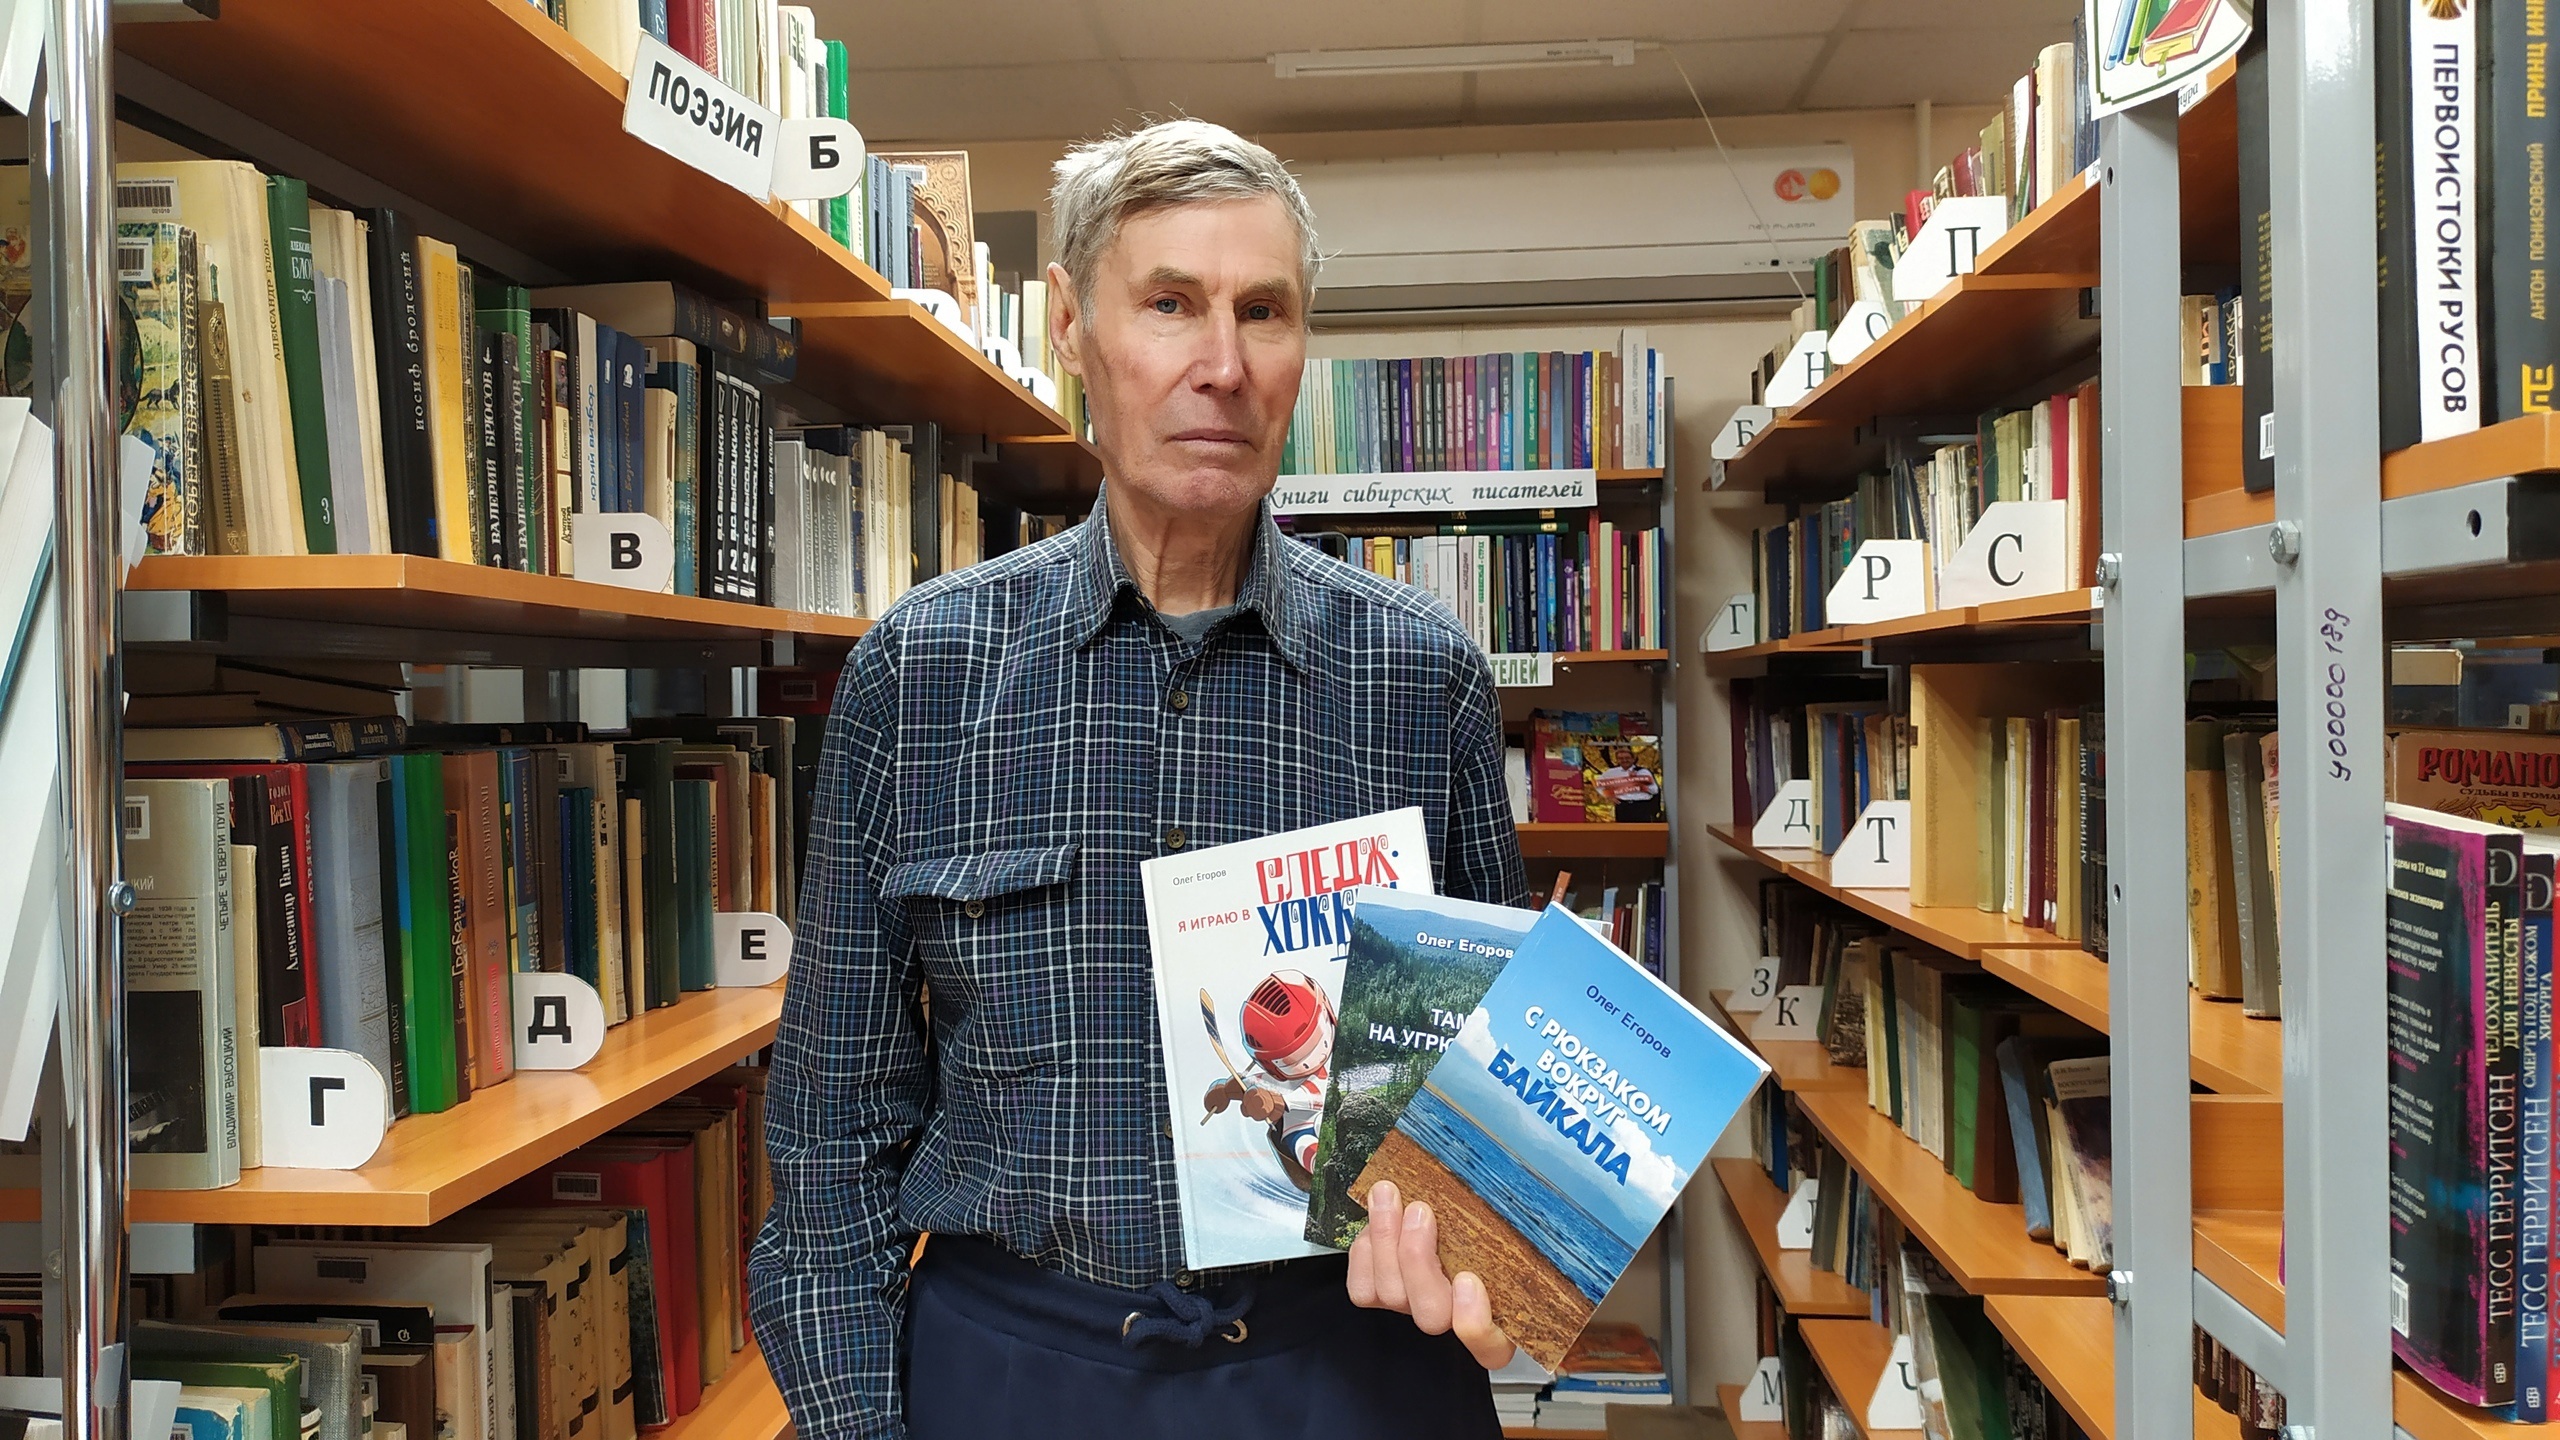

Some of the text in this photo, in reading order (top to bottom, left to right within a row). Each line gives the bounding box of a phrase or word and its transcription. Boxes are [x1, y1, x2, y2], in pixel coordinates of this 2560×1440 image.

[649, 60, 763, 158] ПОЭЗИЯ
[809, 134, 840, 170] Б
[2526, 42, 2546, 320] АНТОН ПОНИЗОВСКИЙ ПРИНЦ
[1944, 226, 1981, 278] П
[2432, 43, 2467, 413] ПЕРВОИСТОКИ РУСОВ
[184, 273, 197, 351] СТИХИ
[262, 238, 281, 362] АЛЕКСАНДР БЛОК
[400, 251, 425, 432] иосиф бродский
[521, 313, 532, 356] БУНИН
[604, 359, 611, 384] 1
[622, 363, 634, 389] 2
[1803, 350, 1828, 390] Н
[483, 370, 500, 546] ВАЛЕРИЙ БРЮСОВ
[586, 383, 597, 502] юрий визбор
[1734, 419, 1755, 448] Б
[511, 379, 528, 551] ВАЛЕРИЙ БРЮСОВ
[716, 414, 725, 571] 1 ВЫСОЦКИЙ
[751, 427, 760, 522] ВЫСОЦКИЙ
[321, 497, 331, 526] 3
[729, 417, 738, 571] 2 ВЫСОЦКИЙ
[742, 423, 752, 573] 3 ВЫСОЦКИЙ
[1266, 478, 1585, 509] Книги сибирских писателей
[610, 532, 643, 571] В
[1861, 554, 1892, 600] Р
[1986, 532, 2025, 587] С
[1729, 602, 1748, 636] Г
[1784, 798, 1811, 834] Д
[2079, 743, 2088, 864] АНТИЧНЫЙ МИР
[2459, 788, 2509, 798] СУДЬБЫ
[480, 785, 493, 861] ГУБЕРМАН
[1866, 816, 1896, 864] Т
[484, 863, 496, 908] Игорь
[1172, 869, 1228, 887] Олег Егоров
[280, 845, 300, 971] Александр Галич
[1178, 908, 1252, 934] Я ИГРАЮ В
[740, 928, 768, 961] Е
[1416, 930, 1515, 960] Олег Егоров
[215, 802, 237, 1150] ВЛАДИМИР ВЫСОЦКИЙ ЧЕТЫРЕ ЧЕТВЕРТИ ПУТИ
[1750, 967, 1771, 997] З
[2503, 917, 2520, 1050] ДЛЯ НЕВЕСТЫ
[527, 995, 573, 1045] Д
[1368, 1022, 1398, 1045] НА
[1585, 983, 1672, 1060] Олег Егоров
[1775, 996, 1800, 1027] К
[2539, 971, 2553, 1041] ХИРУРГА
[390, 1001, 403, 1094] ГЕТЕ ФАУСТ
[1523, 1004, 1673, 1136] С РЮКЗАКОМ
[308, 1076, 346, 1127] Г
[1486, 1047, 1634, 1188] БАЙКАЛА
[1535, 1048, 1627, 1133] ВОКРУГ
[2485, 900, 2517, 1325] ТЕСС ГЕРРИТСЕН ТЕЛОХРАНИТЕЛЬ
[2520, 924, 2550, 1348] ТЕСС ГЕРРИТСЕН СМЕРТЬ ПОД НОЖОМ
[1762, 1370, 1783, 1406] М
